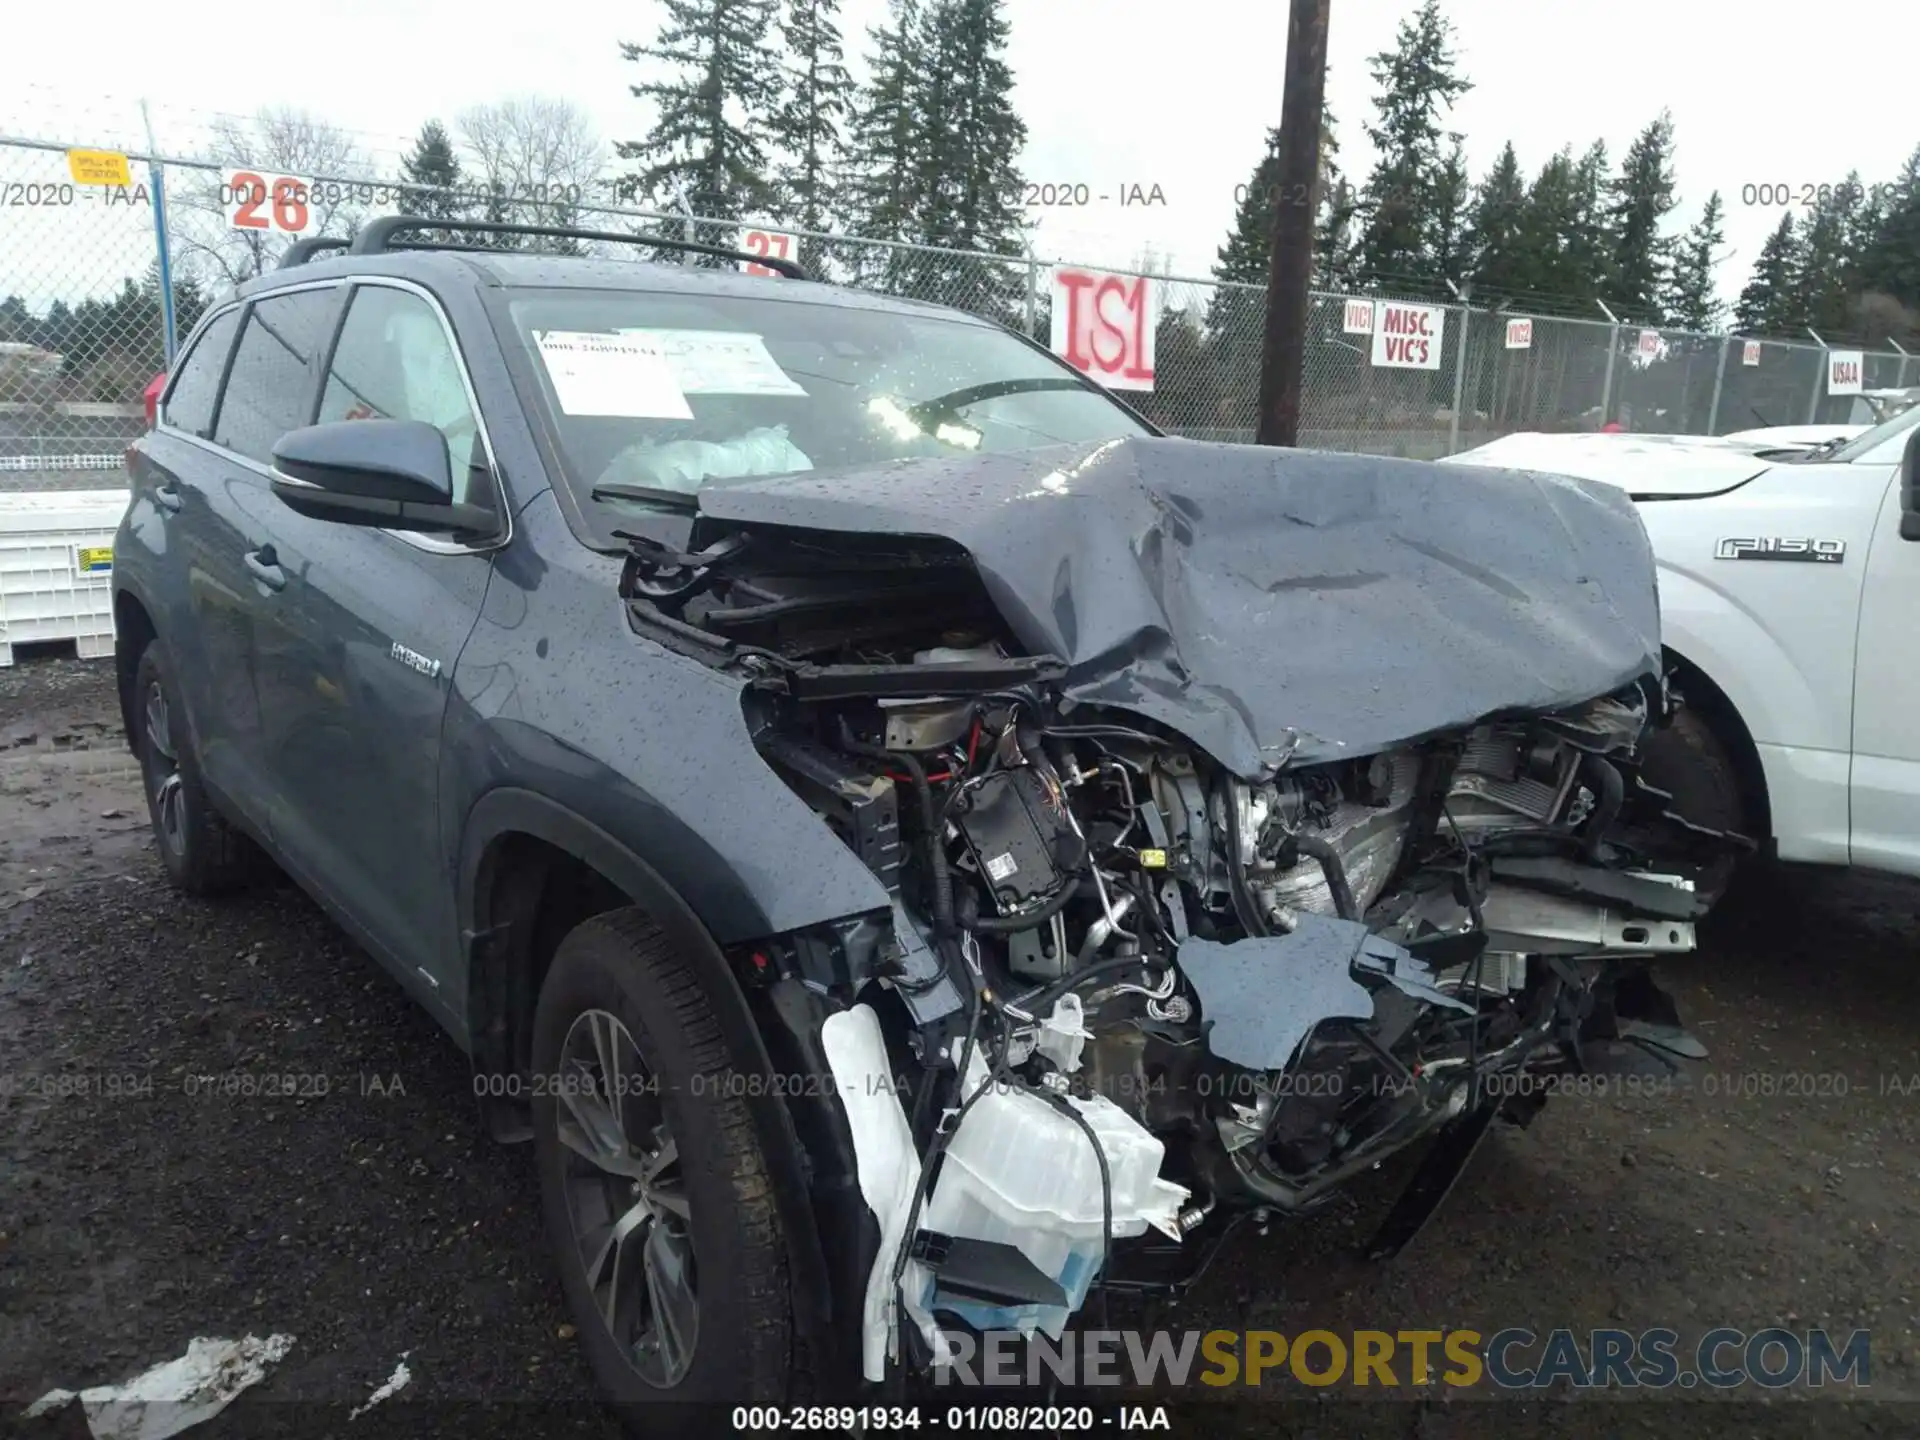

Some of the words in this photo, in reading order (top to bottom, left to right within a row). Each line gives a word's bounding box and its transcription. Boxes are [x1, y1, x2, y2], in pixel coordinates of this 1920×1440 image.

[232, 172, 309, 232] 26
[747, 231, 789, 277] 27
[1384, 308, 1434, 337] MISC.
[1385, 337, 1429, 363] VIC'S
[1832, 361, 1858, 384] USAA
[1816, 554, 1837, 562] XL
